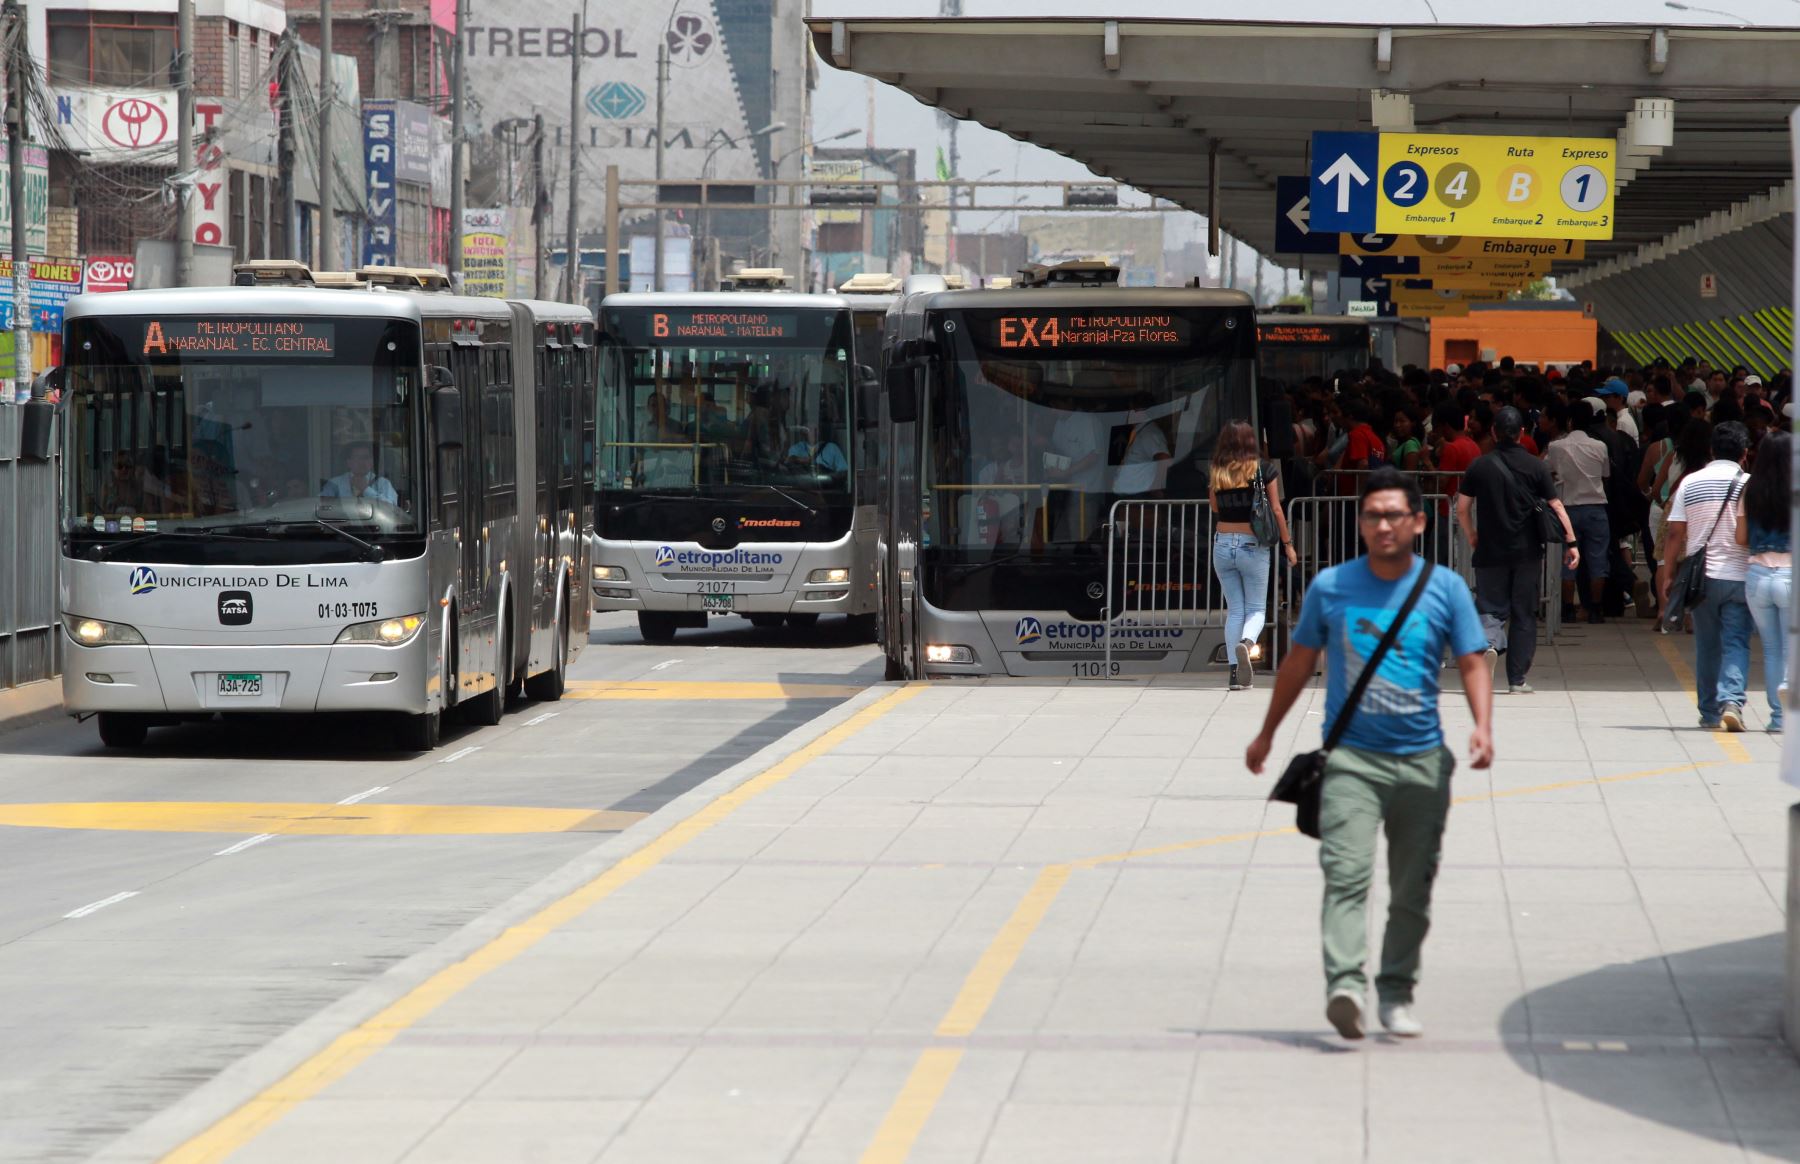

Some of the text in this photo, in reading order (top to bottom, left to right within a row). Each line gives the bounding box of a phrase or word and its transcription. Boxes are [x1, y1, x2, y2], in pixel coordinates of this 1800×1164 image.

[463, 27, 637, 58] TREBOL
[1406, 143, 1459, 157] Expresos
[1507, 146, 1534, 157] Ruta
[1561, 148, 1608, 161] Expreso
[1393, 168, 1468, 201] 2 4
[1507, 172, 1531, 202] B
[1575, 173, 1592, 203] 1
[1405, 211, 1456, 224] Embarque 1
[1492, 213, 1544, 227] Embarque 2
[1556, 215, 1608, 229] Embarque 3
[1483, 240, 1557, 256] Embarque
[653, 313, 669, 337] B
[692, 314, 768, 325] METROPOLITANO
[143, 321, 167, 353] A
[677, 326, 728, 336] NARANJAL
[1000, 317, 1060, 348] EX4
[168, 337, 239, 351] NARANJAL
[275, 337, 333, 351] CENTRAL
[743, 518, 801, 528] modasa
[306, 573, 349, 588] LIMA
[696, 582, 736, 593] 21071
[221, 606, 248, 614] TATSA
[317, 602, 378, 618] 01-03-T075
[1048, 640, 1126, 650] MUNICIPALIAD
[1148, 640, 1173, 649] LIMA
[1072, 662, 1121, 677] 11019
[219, 679, 260, 692] A3A-725
